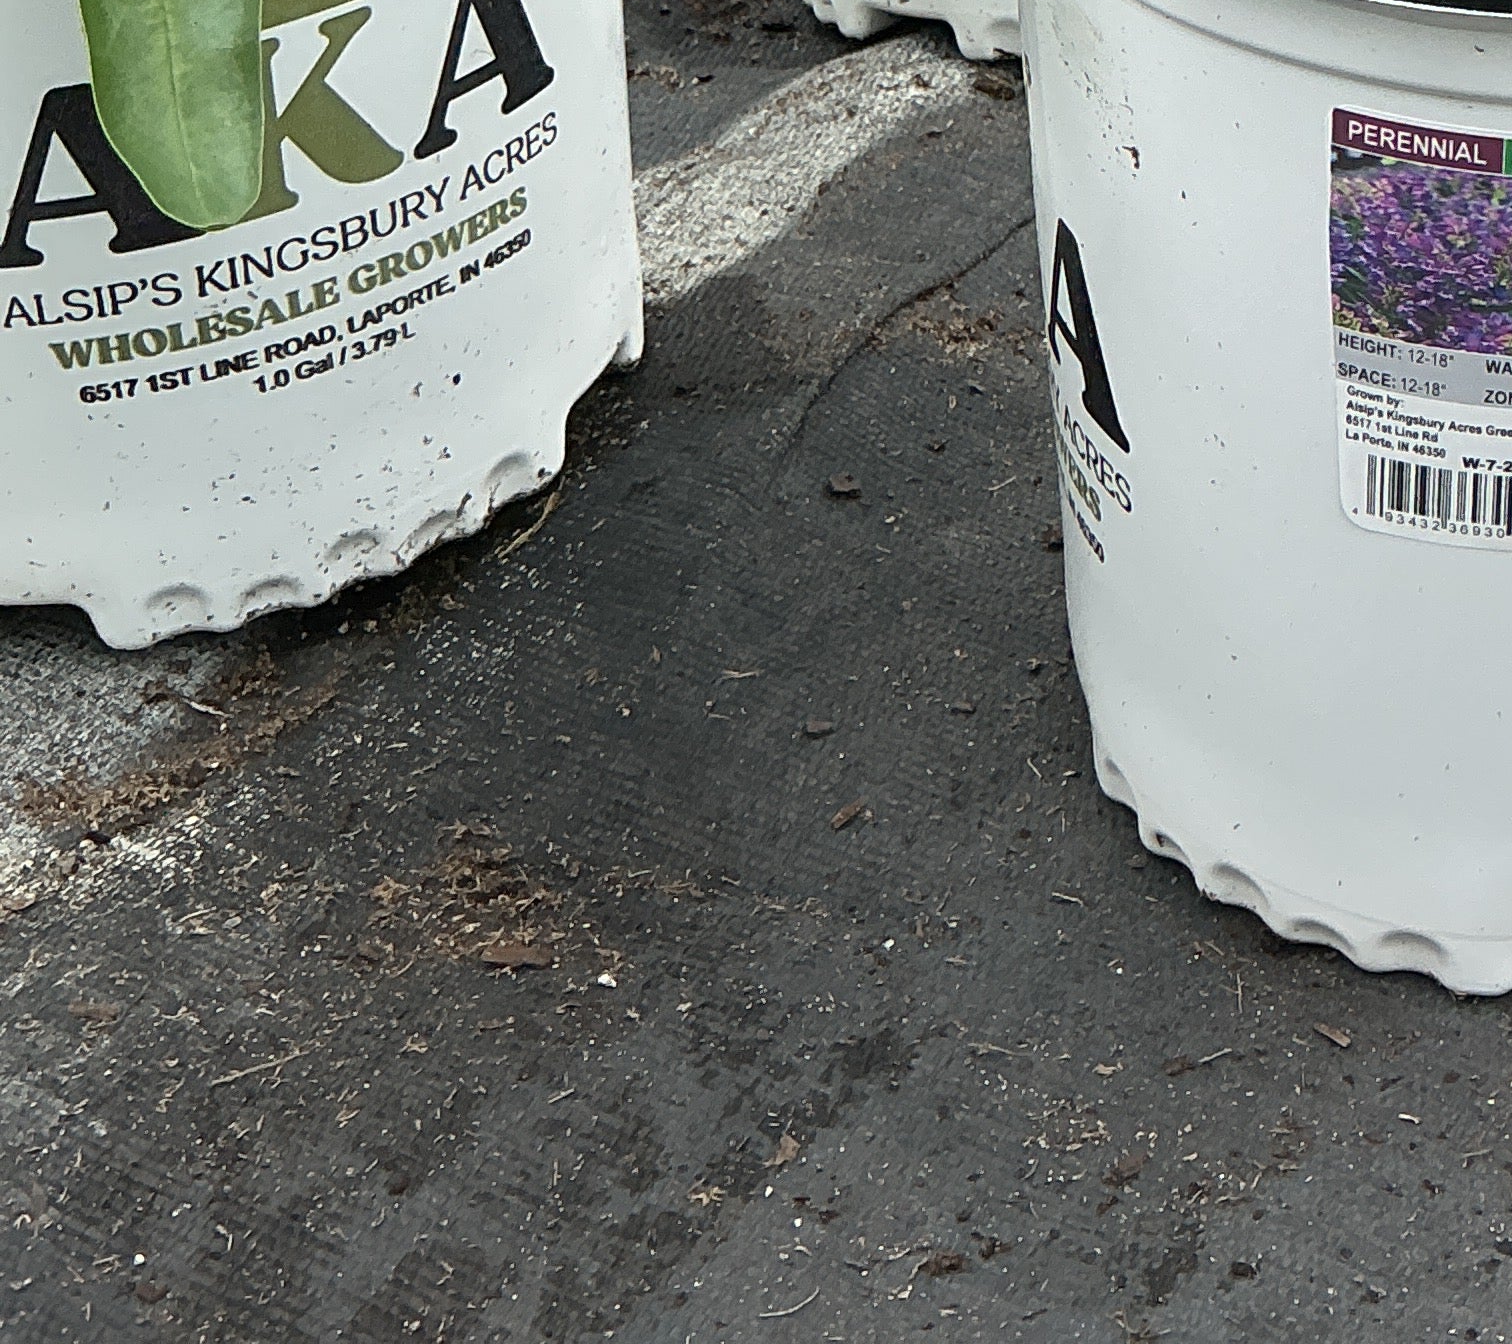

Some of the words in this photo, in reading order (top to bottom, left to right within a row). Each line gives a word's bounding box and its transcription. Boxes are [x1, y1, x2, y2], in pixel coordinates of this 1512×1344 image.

[1348, 120, 1487, 166] PERENNIAL
[3, 272, 182, 329] ALSIP'S
[195, 175, 451, 298] KINGSBURY
[459, 111, 558, 201] ACRES
[48, 275, 341, 370] WHOLESALE
[348, 185, 528, 295] GROWERS
[79, 378, 139, 404] 6517
[145, 366, 195, 394] 1ST
[200, 349, 259, 382] LINE
[458, 259, 481, 285] IN
[483, 228, 532, 270] 46350
[1338, 332, 1402, 360] HEIGHT:
[253, 369, 290, 394] 1.0
[295, 352, 334, 381] Gal
[1337, 362, 1396, 389] SPACE:
[1347, 386, 1383, 404] Grown
[1385, 393, 1404, 409] by:
[1345, 415, 1371, 429] 6517
[1373, 420, 1393, 434] 1st
[1395, 425, 1419, 439] Line
[1421, 429, 1439, 443] Rd
[1386, 407, 1445, 431] Kingsbury
[1448, 420, 1483, 435] Acres
[1063, 404, 1133, 513] ACRES
[1345, 428, 1360, 441] La
[1361, 432, 1395, 451] Porte,
[1397, 440, 1410, 452] IN
[1412, 442, 1446, 459] 46350
